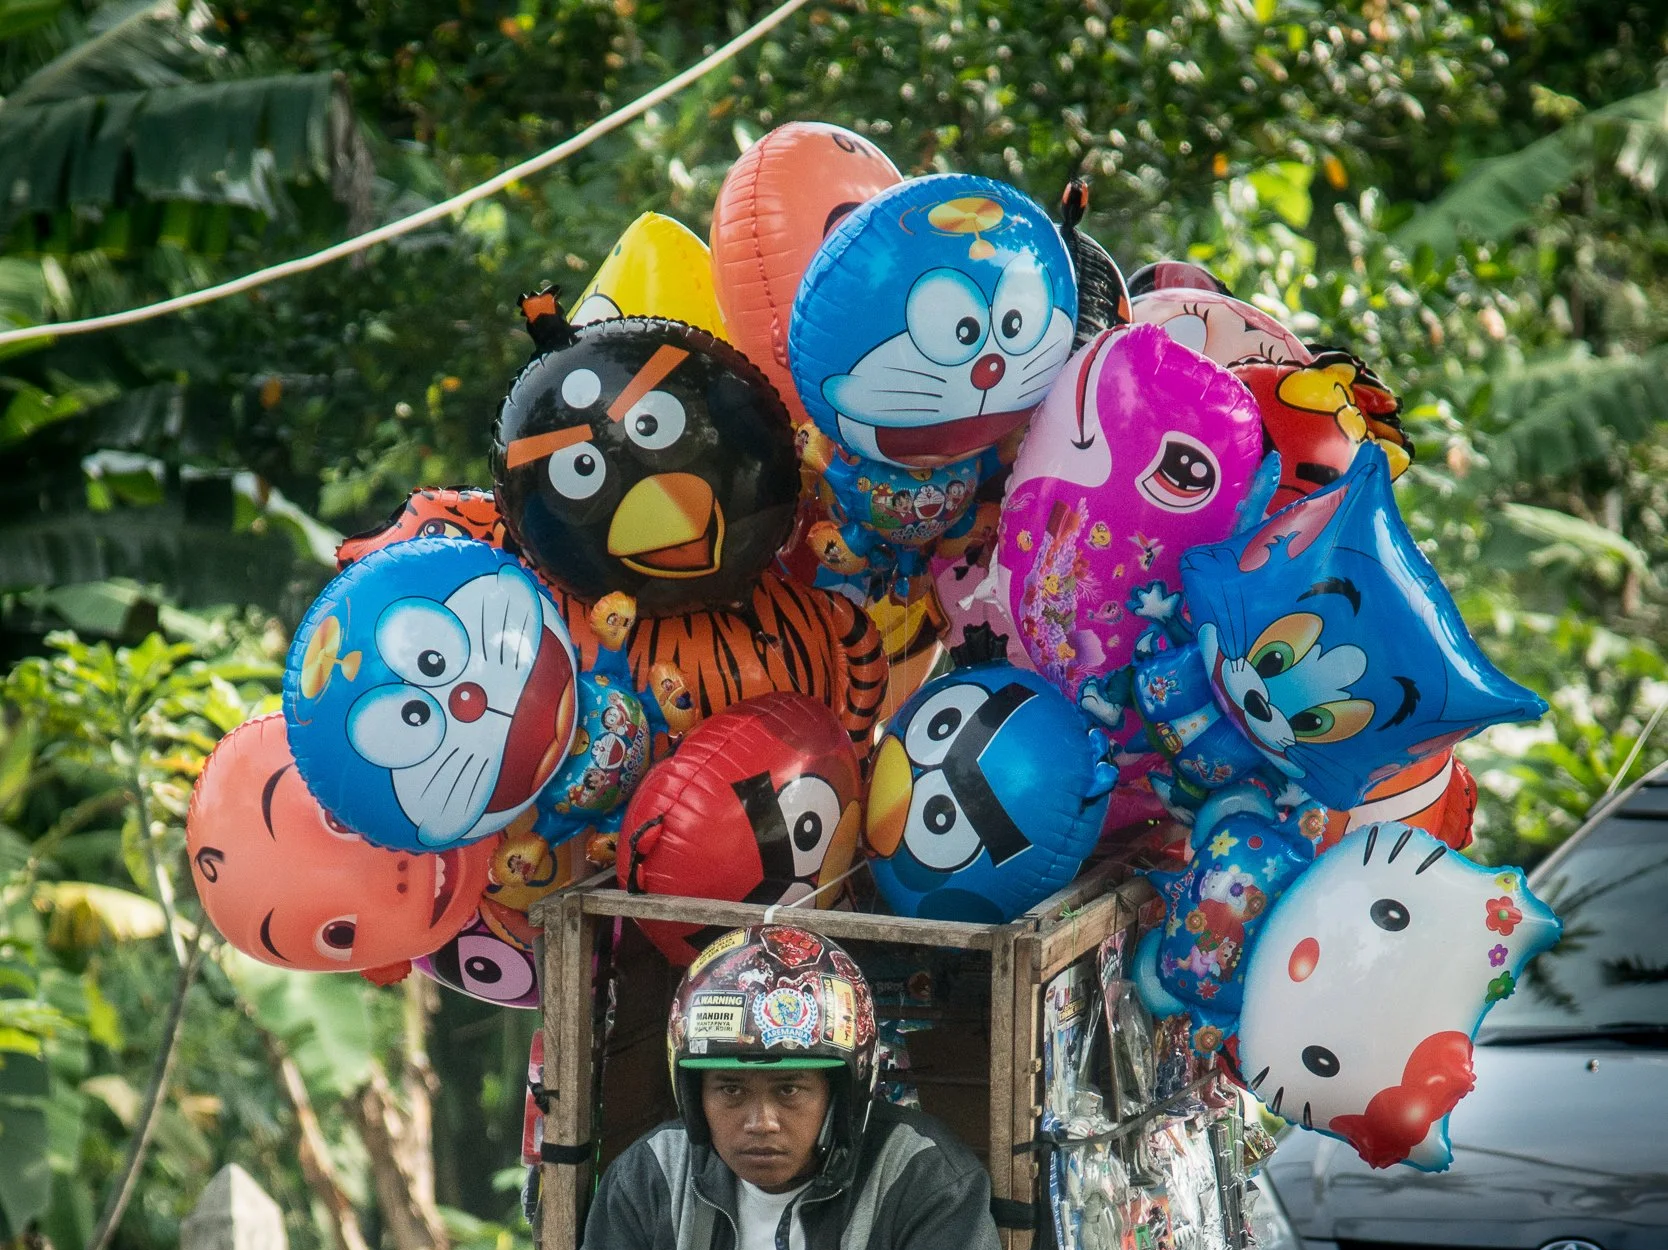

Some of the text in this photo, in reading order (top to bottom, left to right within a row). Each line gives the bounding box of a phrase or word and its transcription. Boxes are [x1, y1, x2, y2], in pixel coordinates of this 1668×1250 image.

[701, 995, 743, 1005] WARNING
[696, 1012, 734, 1020] MANDIRI
[767, 1028, 808, 1040] AREMANIA
